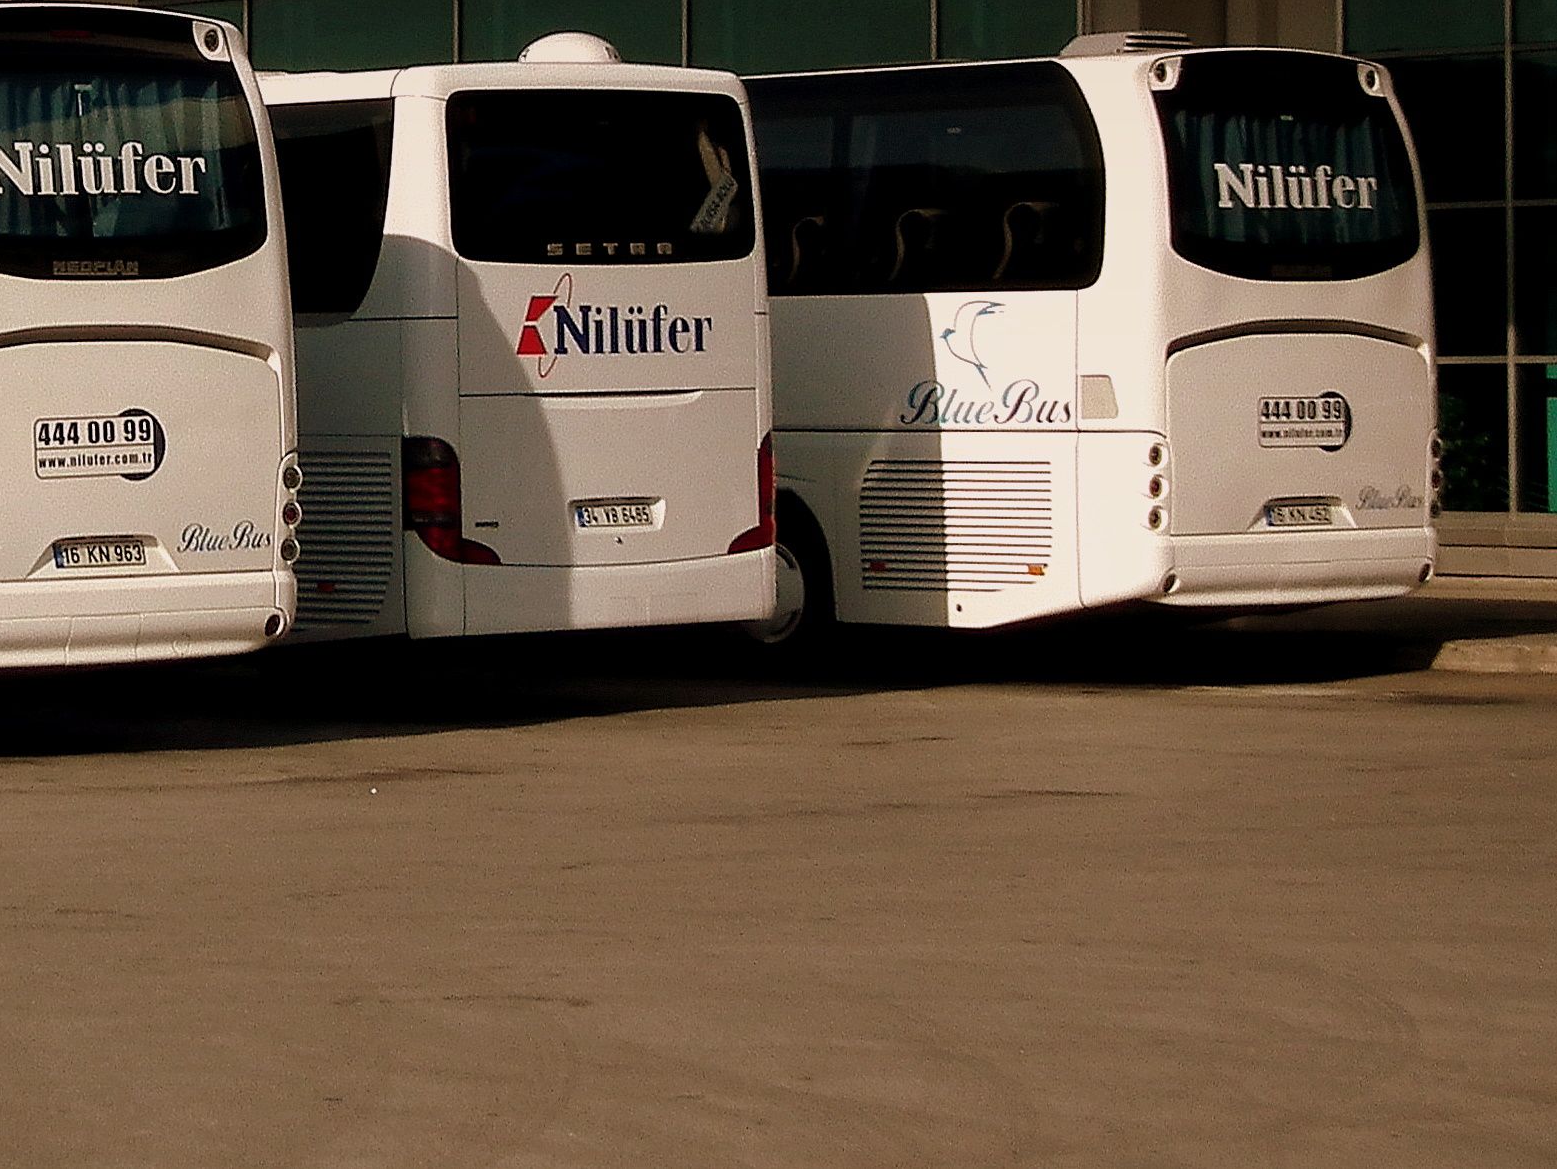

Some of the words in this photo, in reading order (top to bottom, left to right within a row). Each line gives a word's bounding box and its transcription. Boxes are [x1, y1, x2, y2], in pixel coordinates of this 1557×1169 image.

[1213, 163, 1377, 209] Nilüfer
[553, 304, 713, 355] Nilüfer
[1260, 400, 1292, 420] 444
[1296, 400, 1317, 420] 00
[1321, 399, 1342, 419] 99
[38, 421, 80, 446] 444
[87, 420, 116, 444] 00
[123, 418, 151, 443] 99
[584, 508, 598, 524] 34
[64, 547, 80, 564] 16
[87, 545, 110, 563] KN
[114, 543, 143, 562] 963
